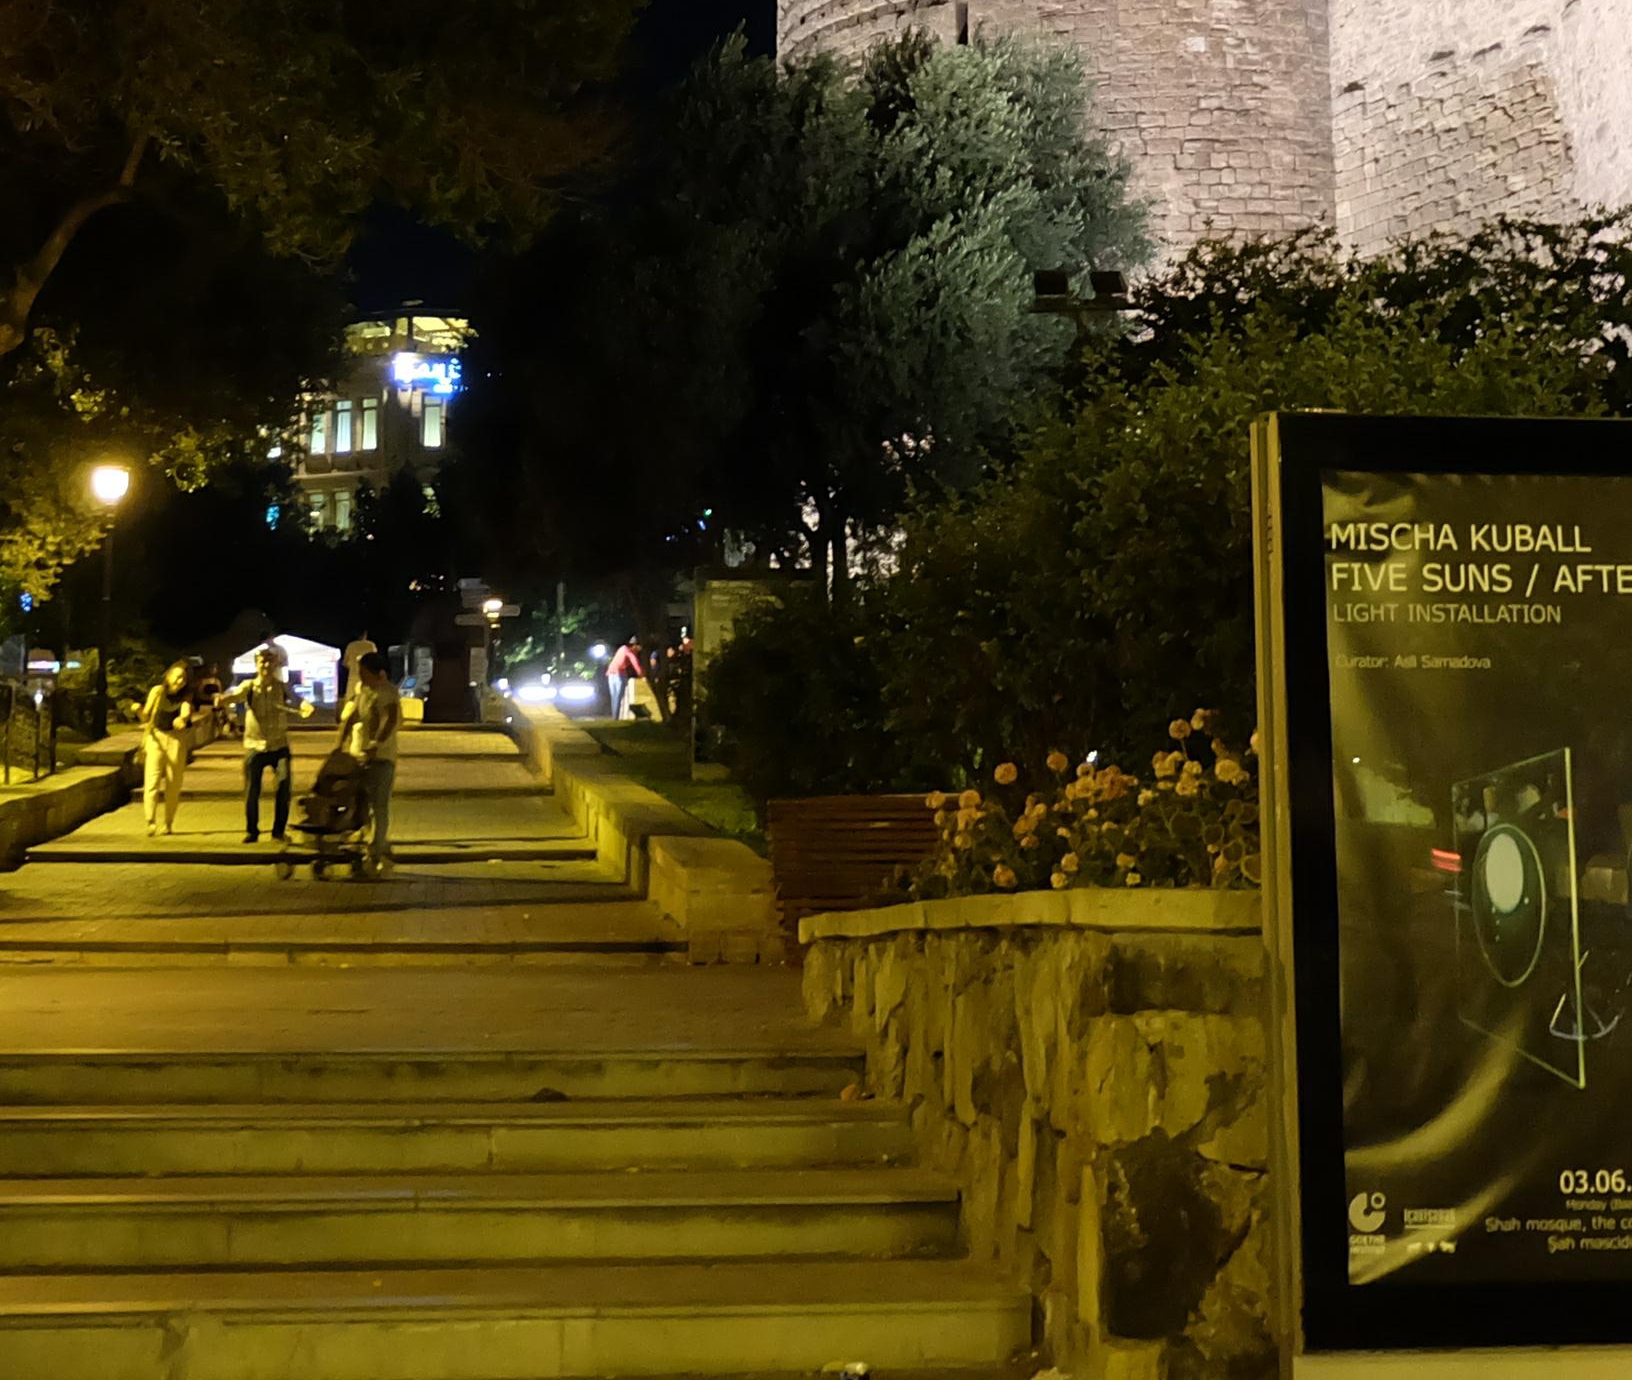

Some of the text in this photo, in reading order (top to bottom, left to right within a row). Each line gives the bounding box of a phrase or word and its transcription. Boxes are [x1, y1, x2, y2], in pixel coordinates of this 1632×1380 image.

[1331, 522, 1592, 553] MISCHA KUBALL
[1331, 562, 1408, 592] FIVE
[1421, 563, 1514, 594] SUNS
[1524, 563, 1540, 599] /
[1333, 602, 1562, 624] LIGHT INSTALLATION
[1484, 1217, 1522, 1233] Shah
[1525, 1218, 1587, 1233] mosque,
[1591, 1215, 1616, 1230] the
